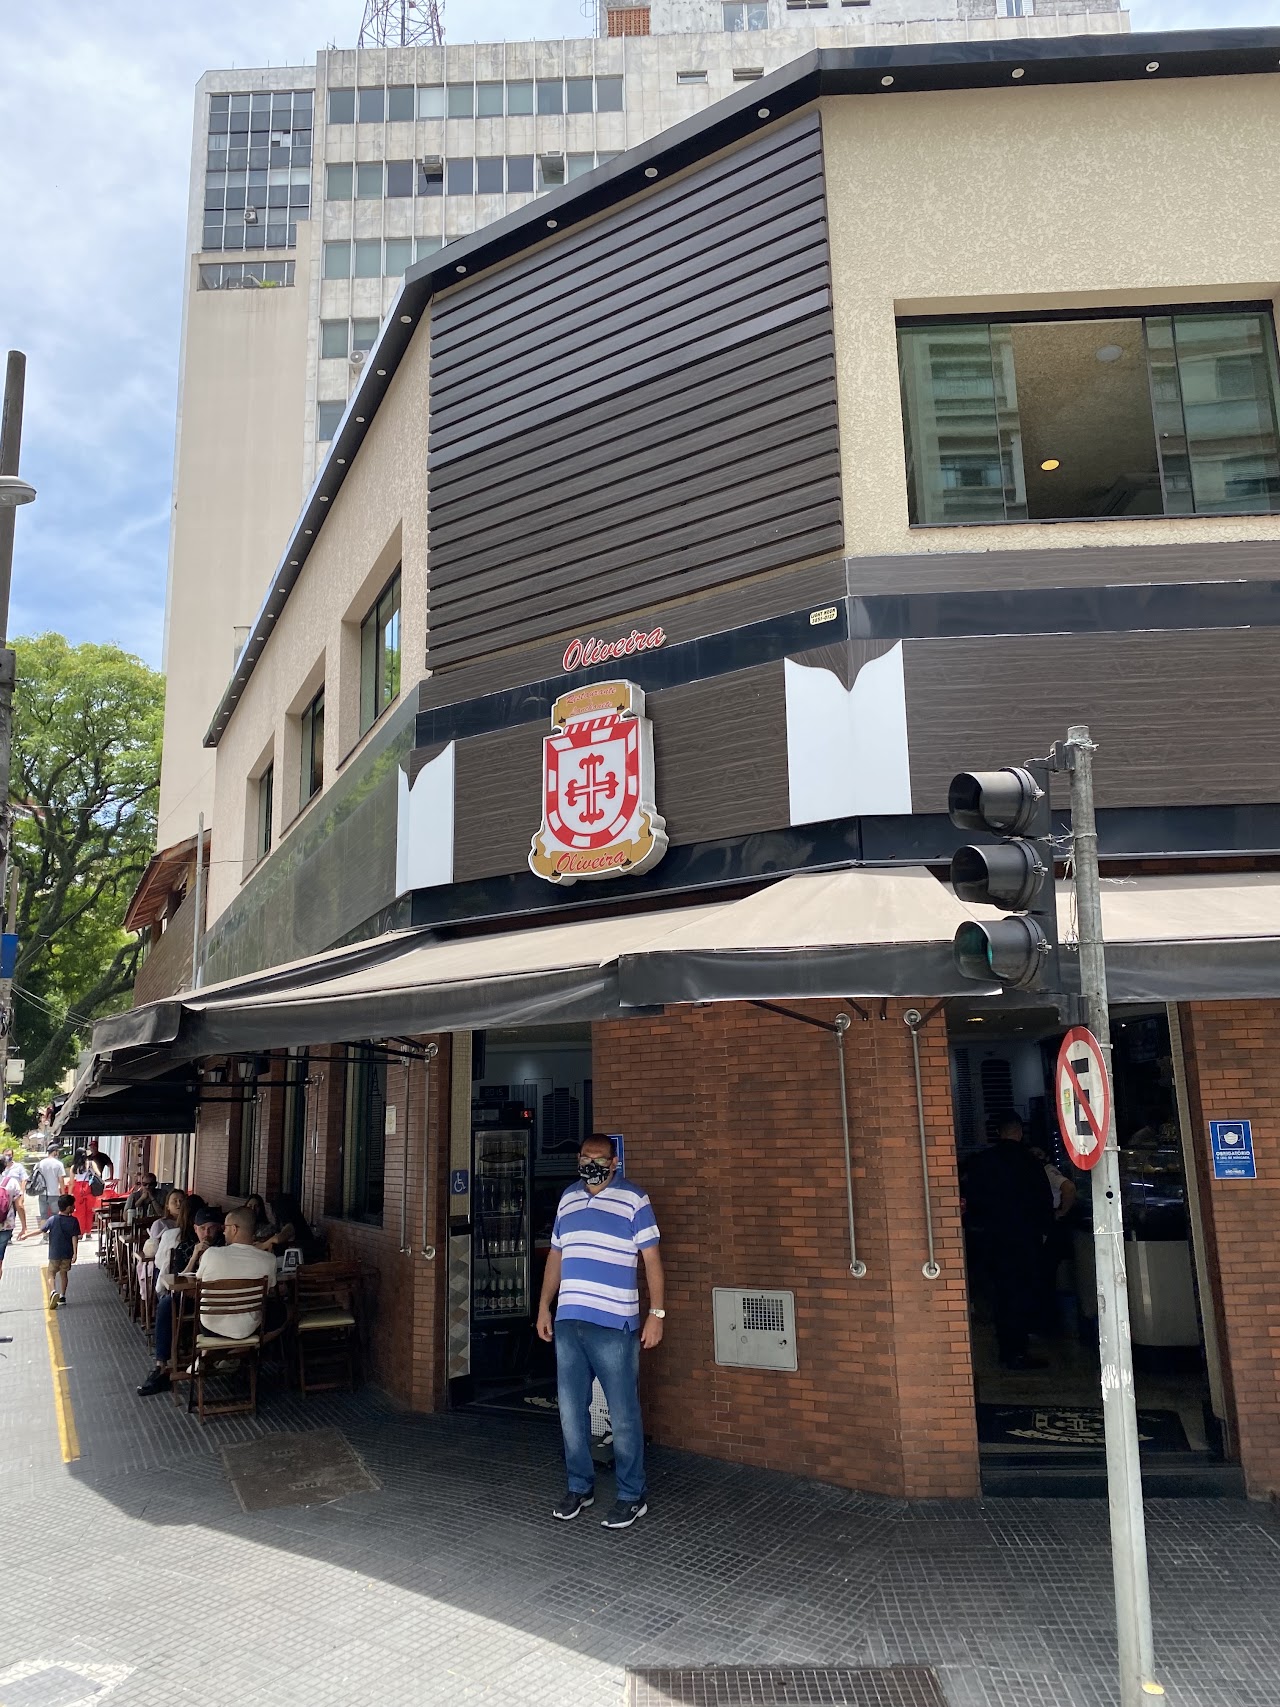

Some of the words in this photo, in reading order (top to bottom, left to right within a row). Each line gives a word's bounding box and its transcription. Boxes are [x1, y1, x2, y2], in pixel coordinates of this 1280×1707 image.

[563, 627, 666, 671] Oliveira
[566, 687, 616, 704] Restaurante
[556, 851, 625, 872] Oliveira
